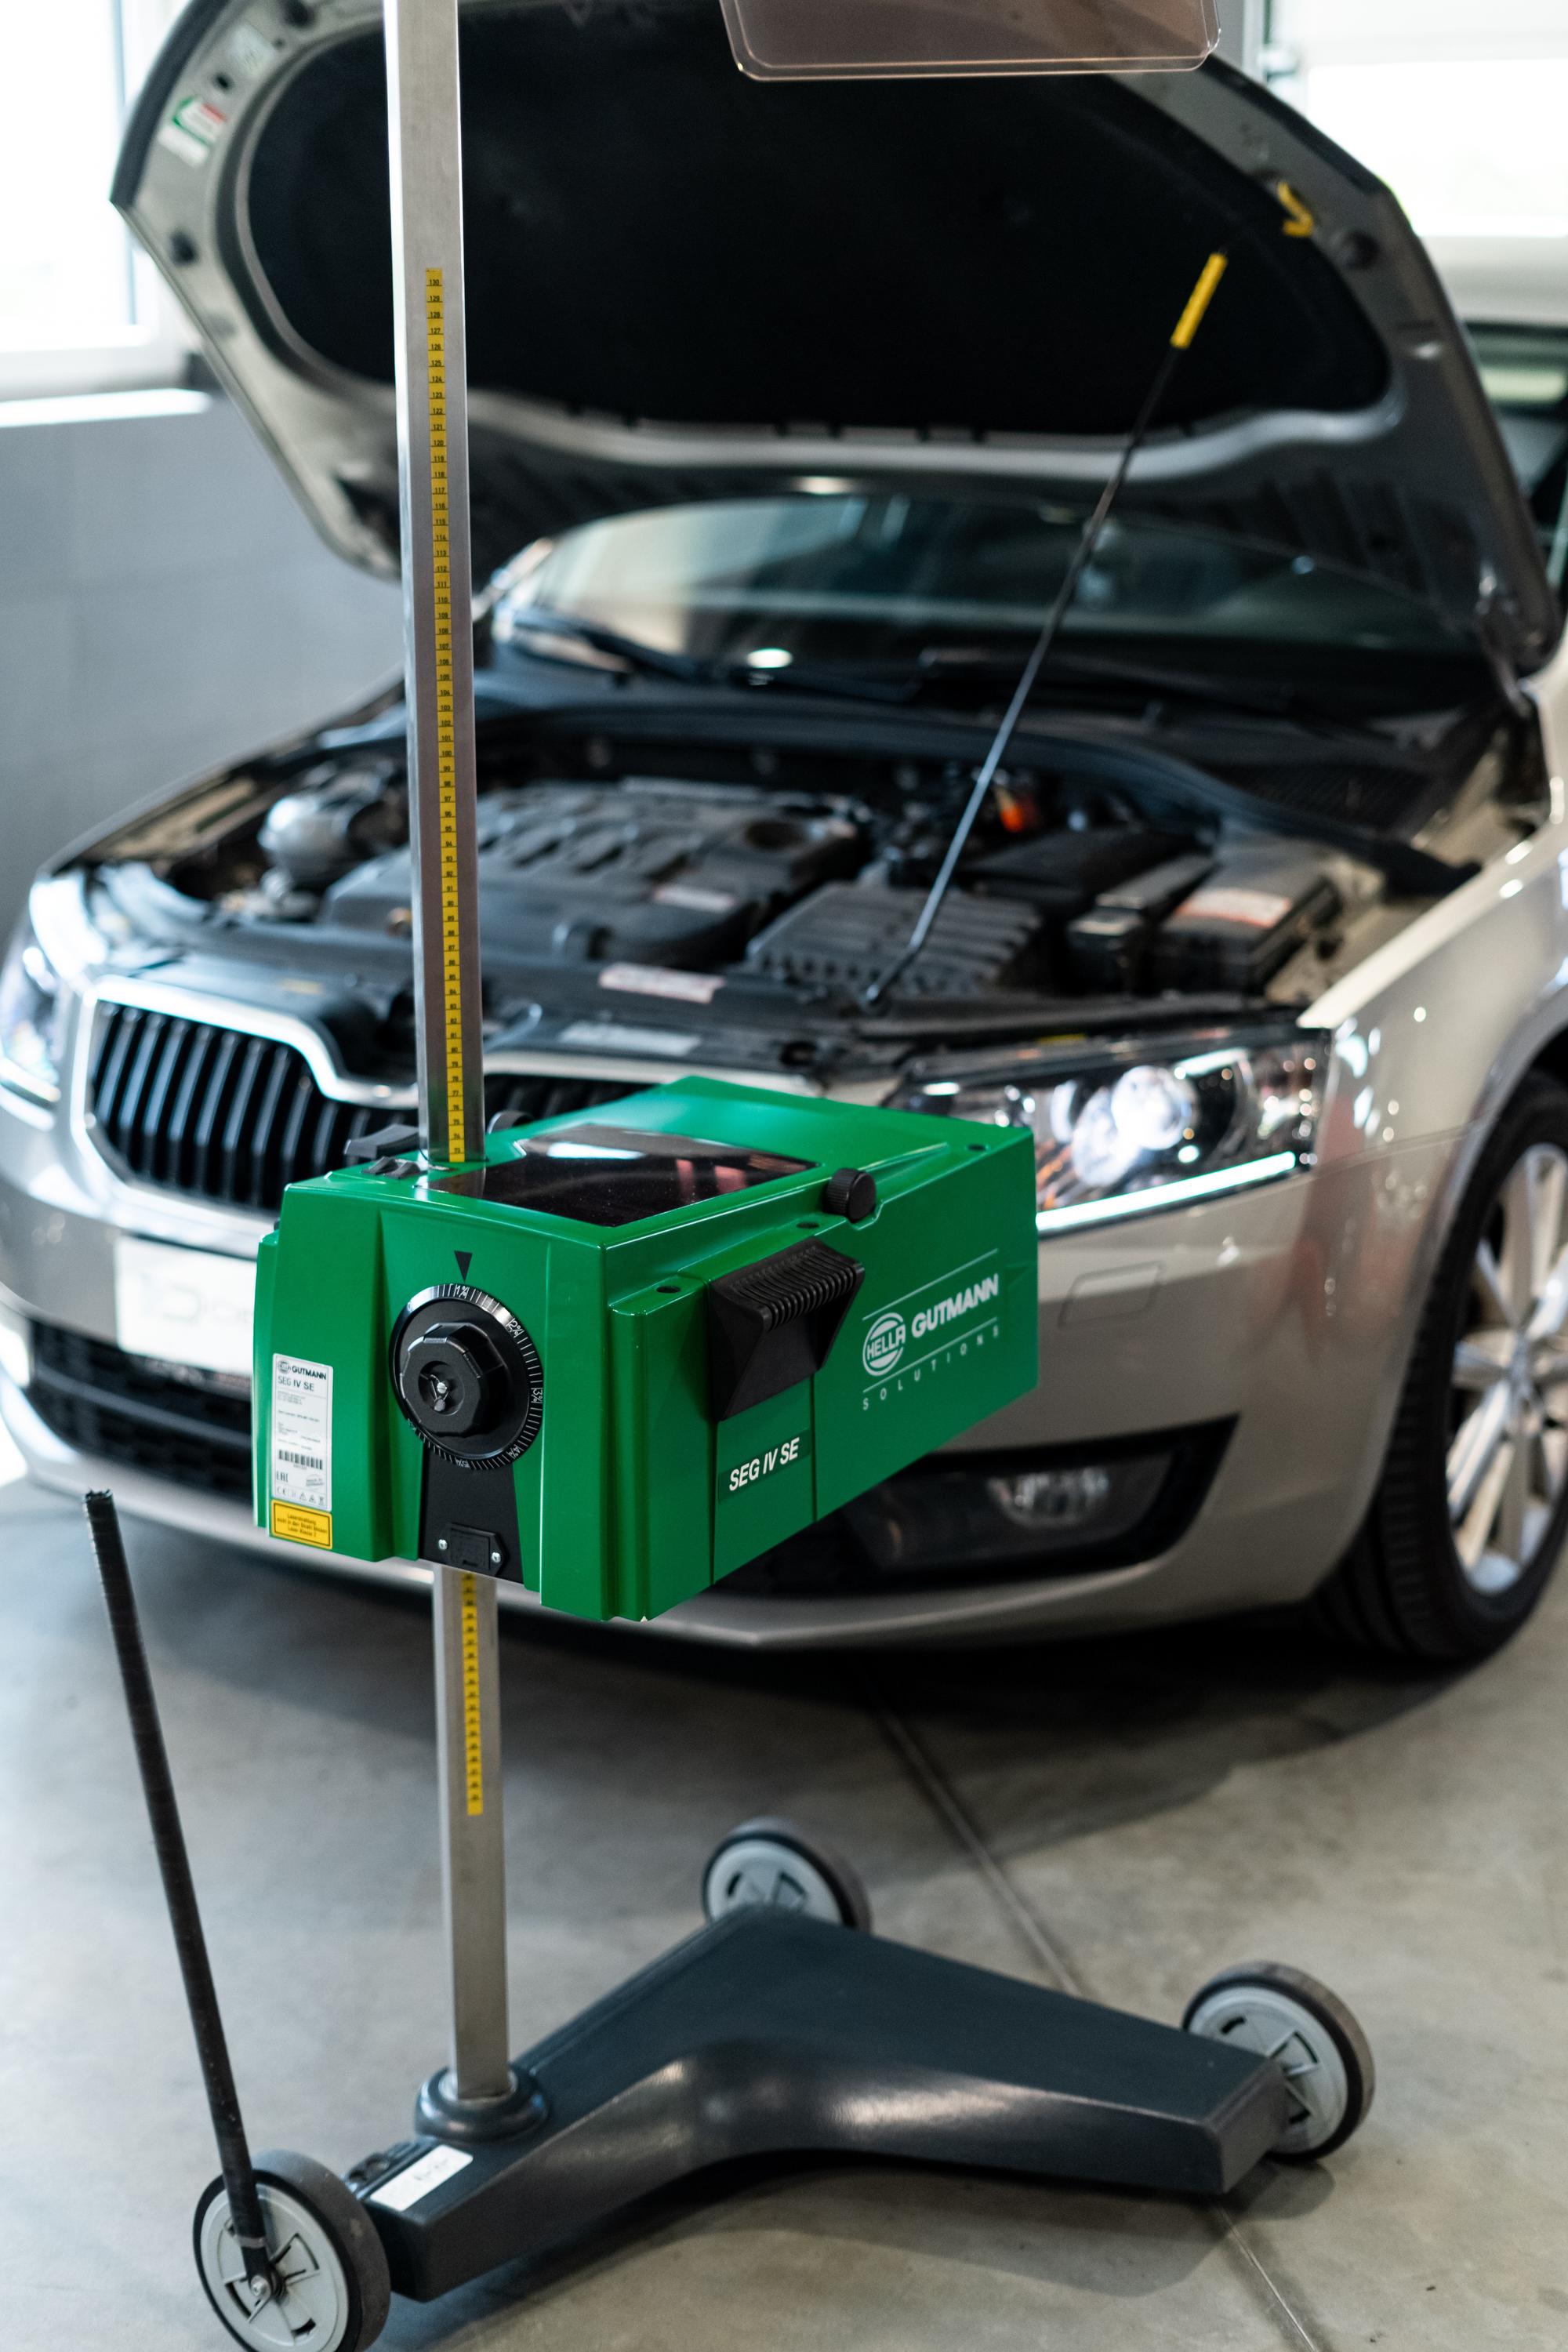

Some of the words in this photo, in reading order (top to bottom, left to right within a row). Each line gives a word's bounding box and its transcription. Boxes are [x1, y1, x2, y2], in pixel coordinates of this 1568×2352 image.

[867, 1324, 906, 1360] HELLA
[912, 1273, 998, 1338] GUTMANN
[278, 1376, 292, 1386] SEG
[293, 1379, 302, 1388] IV
[303, 1381, 314, 1392] SE
[292, 1366, 327, 1380] GUTMANN
[862, 1325, 998, 1410] SOLUTIONS
[729, 1458, 760, 1491] SEG
[763, 1448, 778, 1475] IV
[780, 1437, 800, 1465] SE
